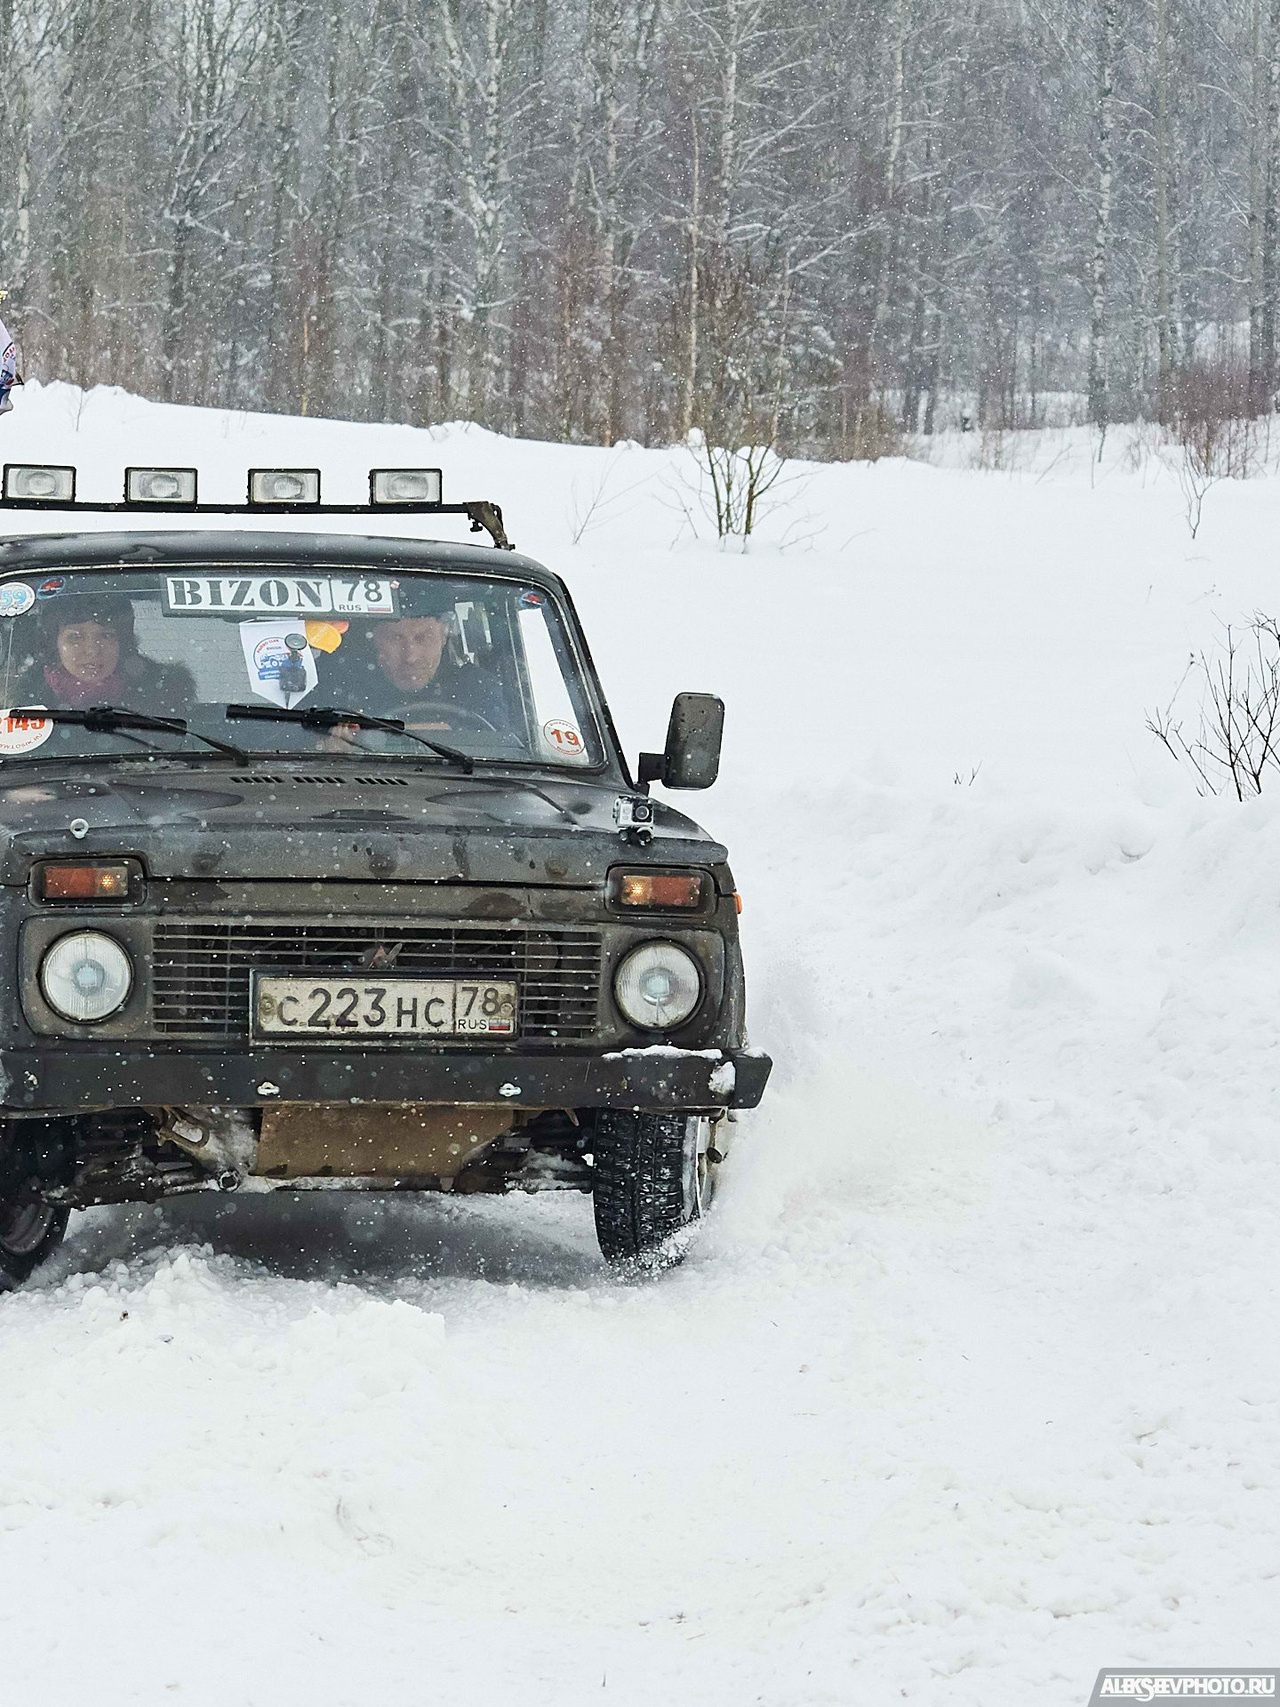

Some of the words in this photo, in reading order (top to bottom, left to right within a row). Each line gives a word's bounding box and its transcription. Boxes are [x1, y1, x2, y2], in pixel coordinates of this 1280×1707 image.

[0, 588, 27, 607] 59
[170, 579, 323, 608] BIZON
[342, 579, 383, 603] 78
[551, 729, 579, 745] 19
[461, 986, 501, 1017] 78
[457, 1019, 487, 1030] RUS
